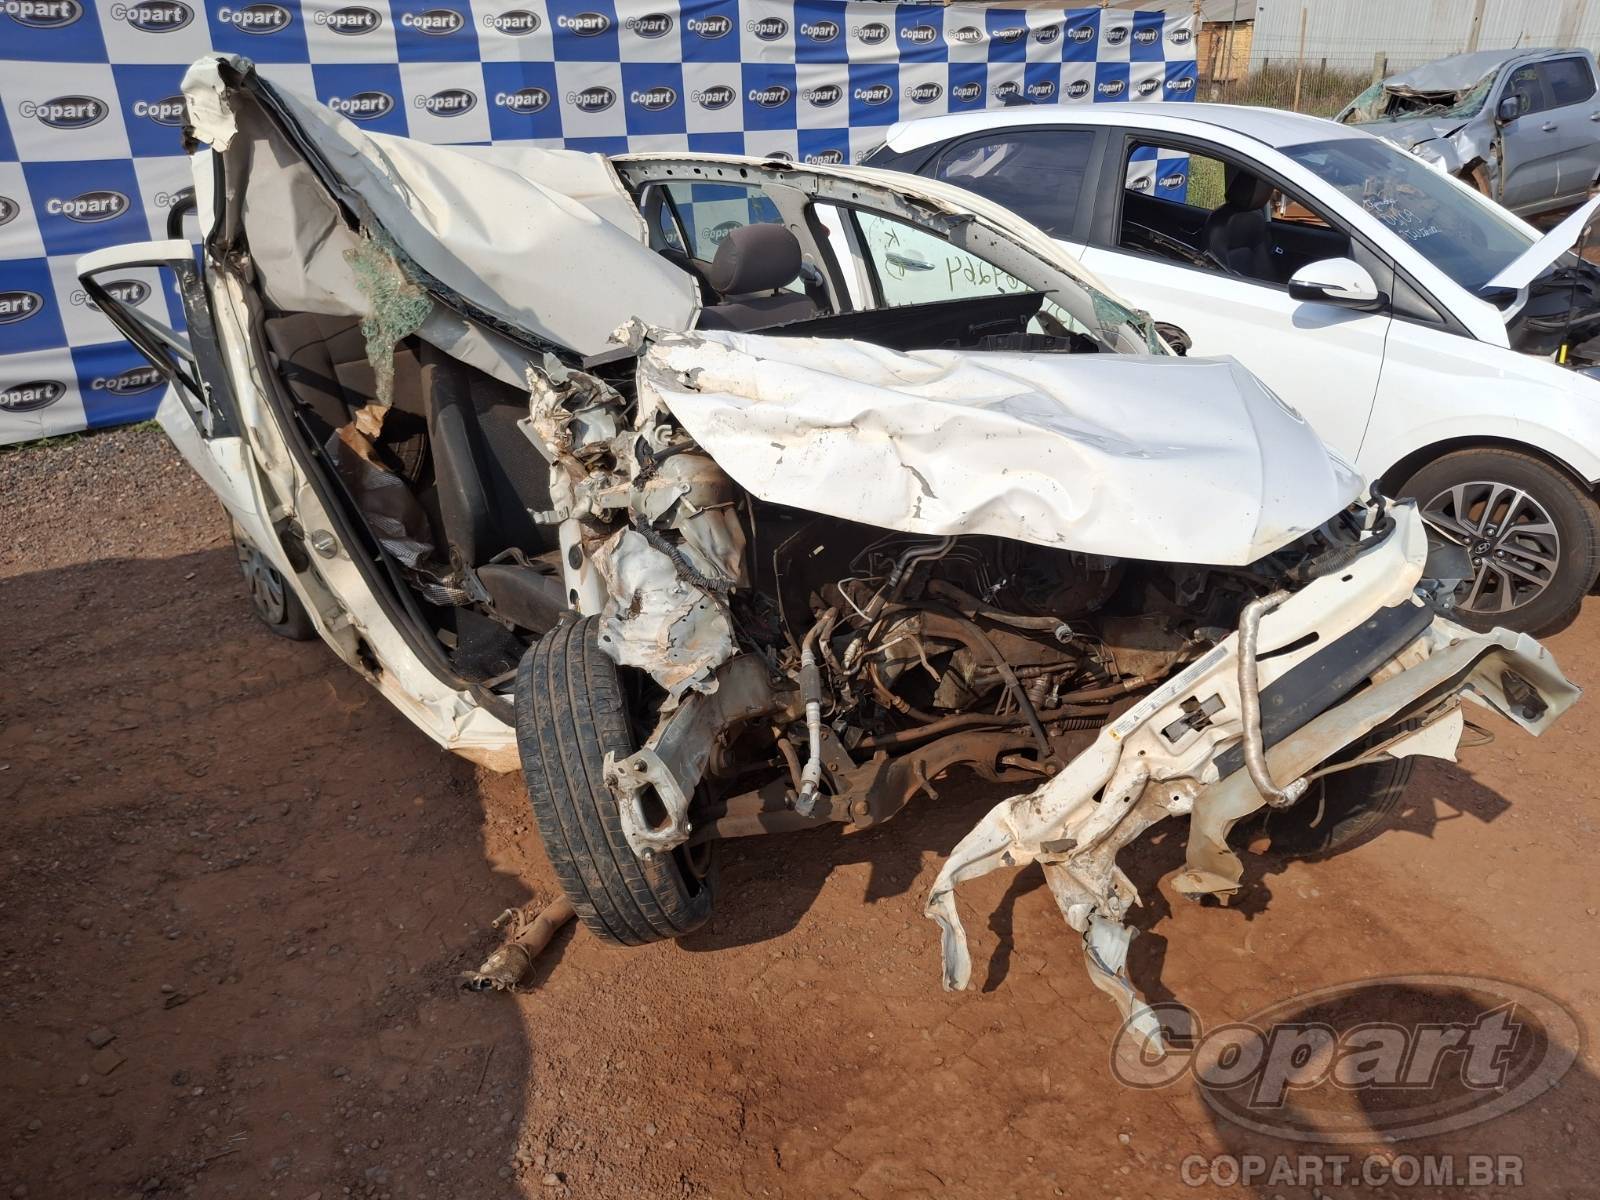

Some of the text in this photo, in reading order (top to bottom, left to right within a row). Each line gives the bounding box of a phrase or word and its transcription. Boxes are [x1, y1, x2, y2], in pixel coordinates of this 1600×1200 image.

[111, 3, 182, 23] Copart
[218, 8, 281, 26] Copart
[314, 12, 371, 25] Copart
[401, 13, 455, 27] Copart
[483, 14, 533, 28] Copart
[557, 16, 604, 29] Copart
[625, 17, 666, 31] Copart
[687, 19, 726, 32] Copart
[747, 21, 783, 35] Copart
[800, 24, 835, 37] Copart
[852, 26, 884, 39] Copart
[900, 28, 933, 41] Copart
[949, 31, 979, 41] Copart
[1068, 28, 1091, 40] Copart
[1134, 31, 1155, 42] Copart
[952, 84, 979, 98] Copart
[1028, 83, 1052, 96] Copart
[1098, 82, 1123, 97] Copart
[1166, 79, 1192, 92] Copart
[495, 92, 543, 107] Copart
[566, 91, 609, 106] Copart
[631, 91, 671, 105] Copart
[691, 90, 729, 104] Copart
[749, 89, 786, 104] Copart
[802, 88, 837, 103] Copart
[854, 87, 888, 101] Copart
[905, 86, 937, 101] Copart
[134, 101, 183, 118] Copa
[328, 96, 385, 112] Copart
[414, 94, 469, 111] Copart
[19, 100, 96, 120] Copart
[805, 153, 838, 165] Copart
[48, 195, 118, 216] Copart
[0, 384, 53, 407] opart
